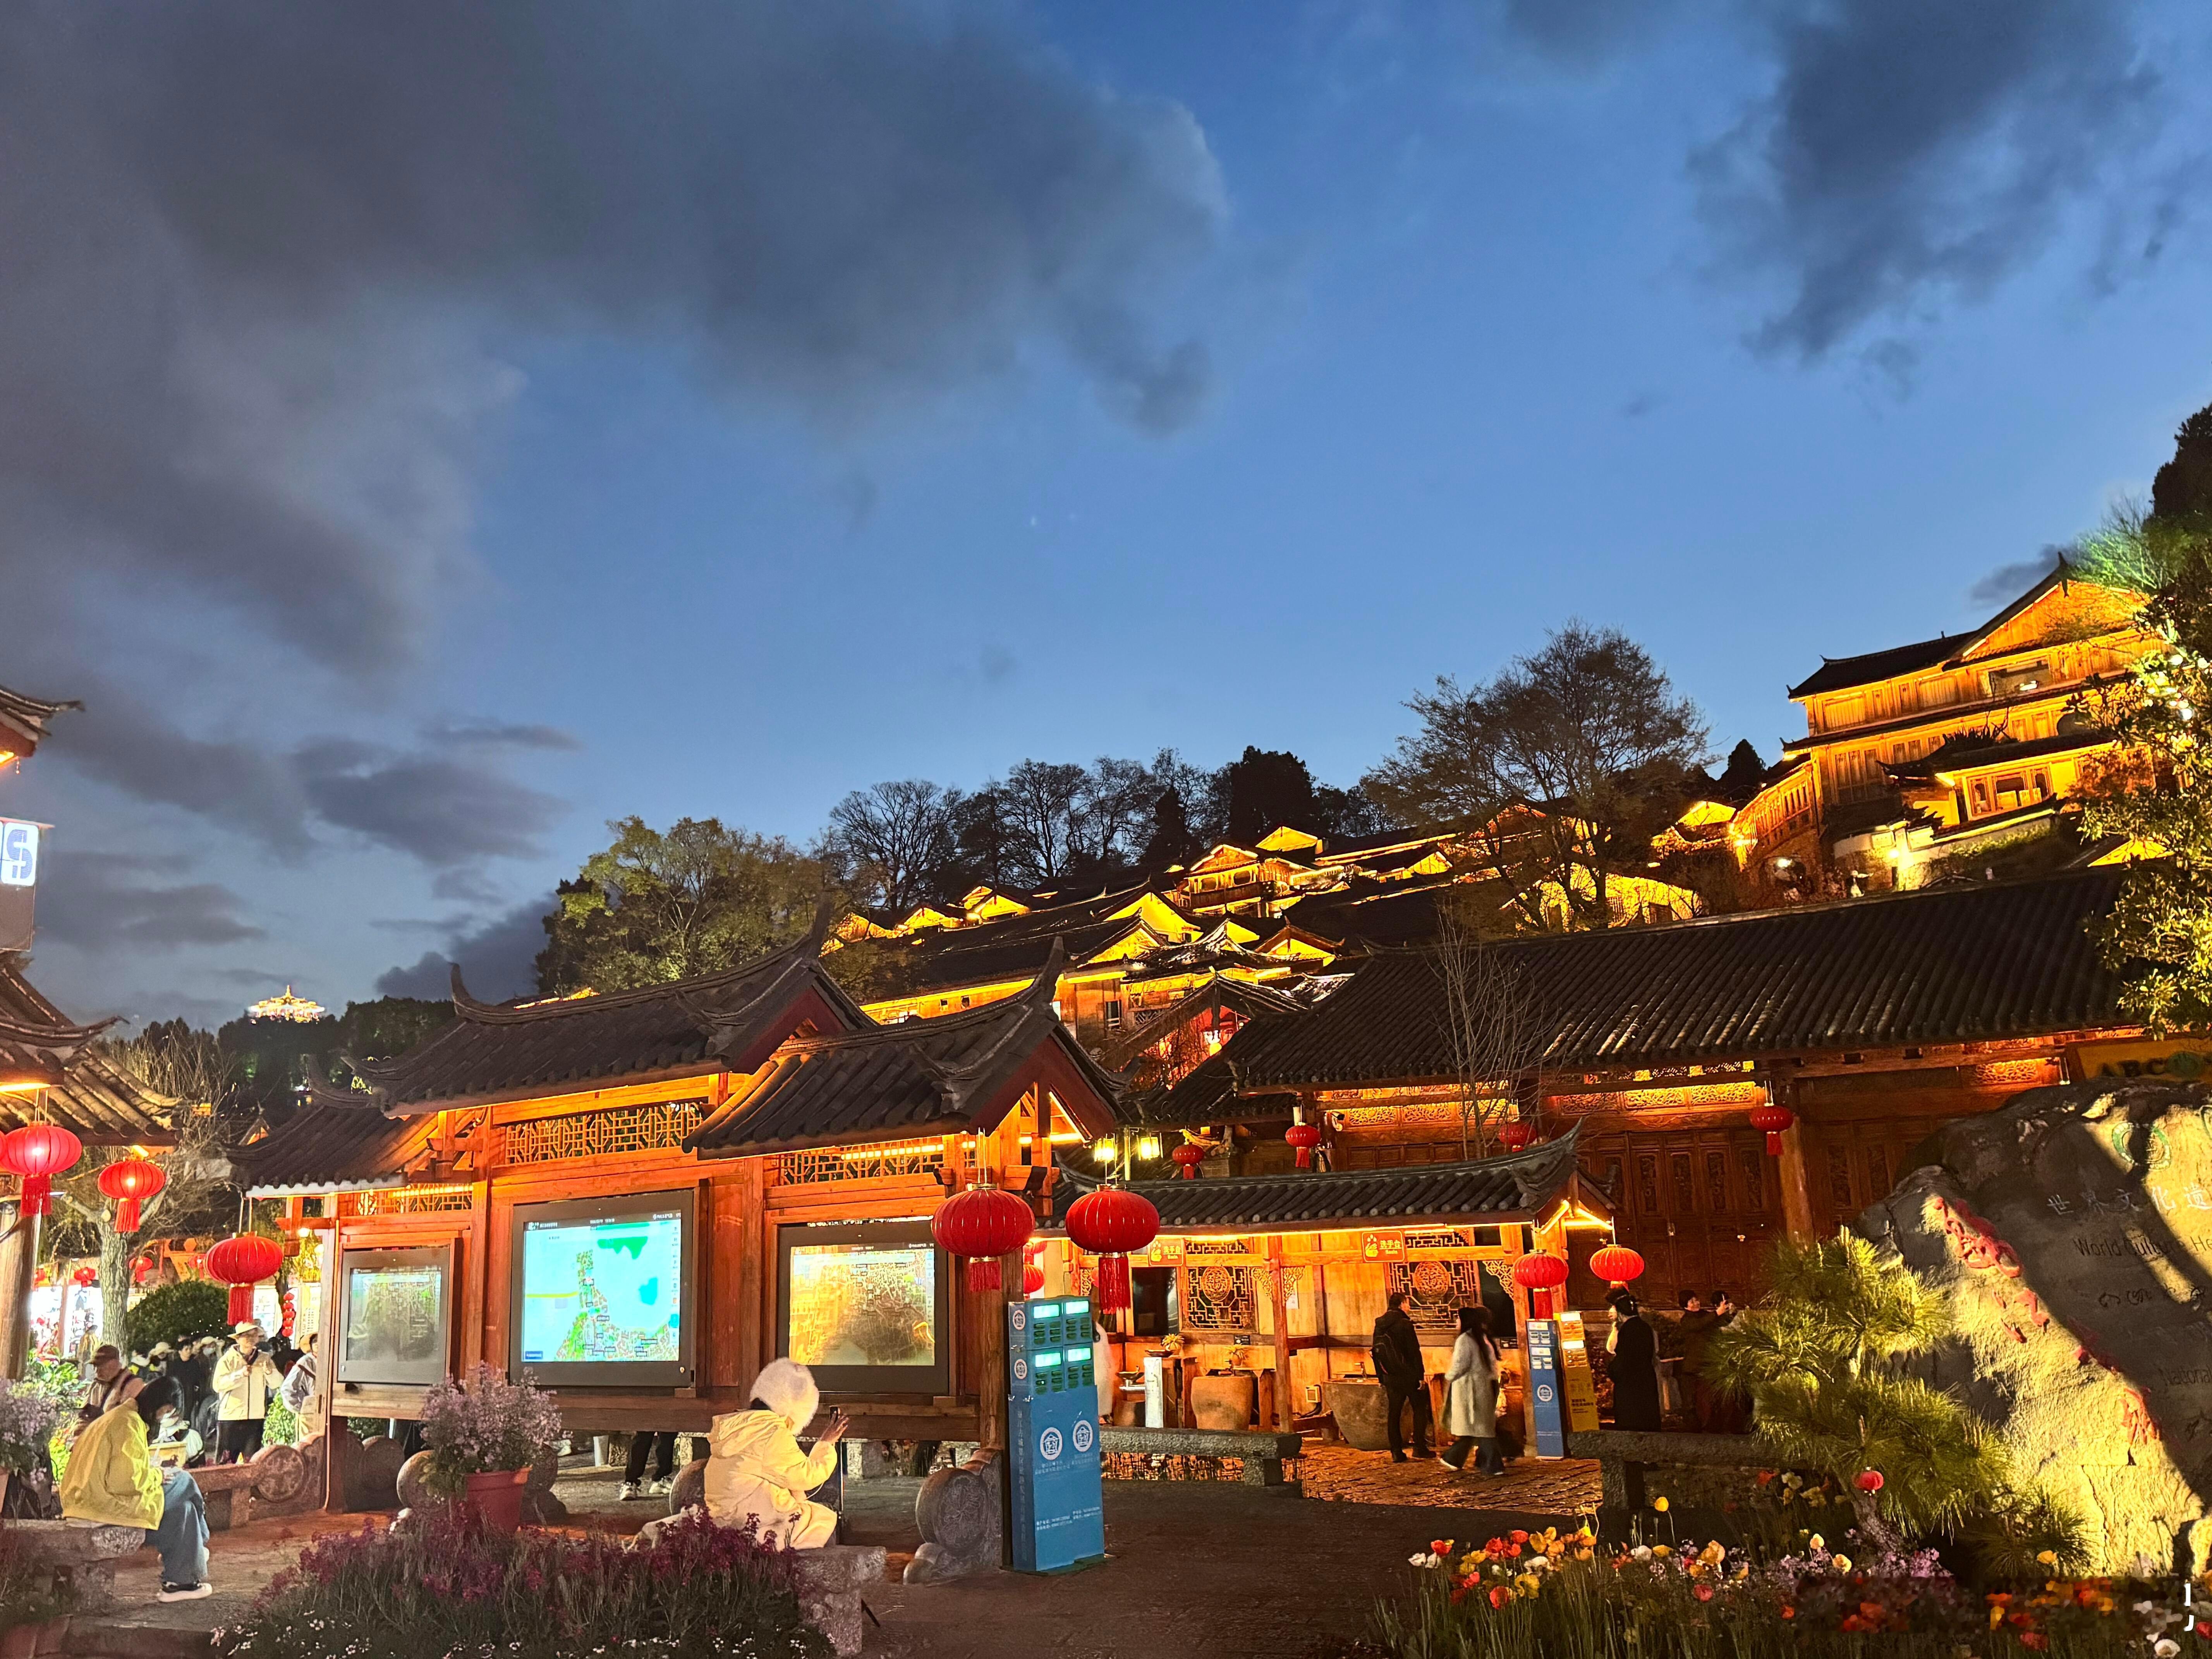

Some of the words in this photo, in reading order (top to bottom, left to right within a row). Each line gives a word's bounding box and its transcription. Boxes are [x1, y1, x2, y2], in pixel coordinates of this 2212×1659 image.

[1380, 1239, 1401, 1248] 洗手台
[2073, 1238, 2122, 1257] World
[2123, 1236, 2182, 1256] Cultur
